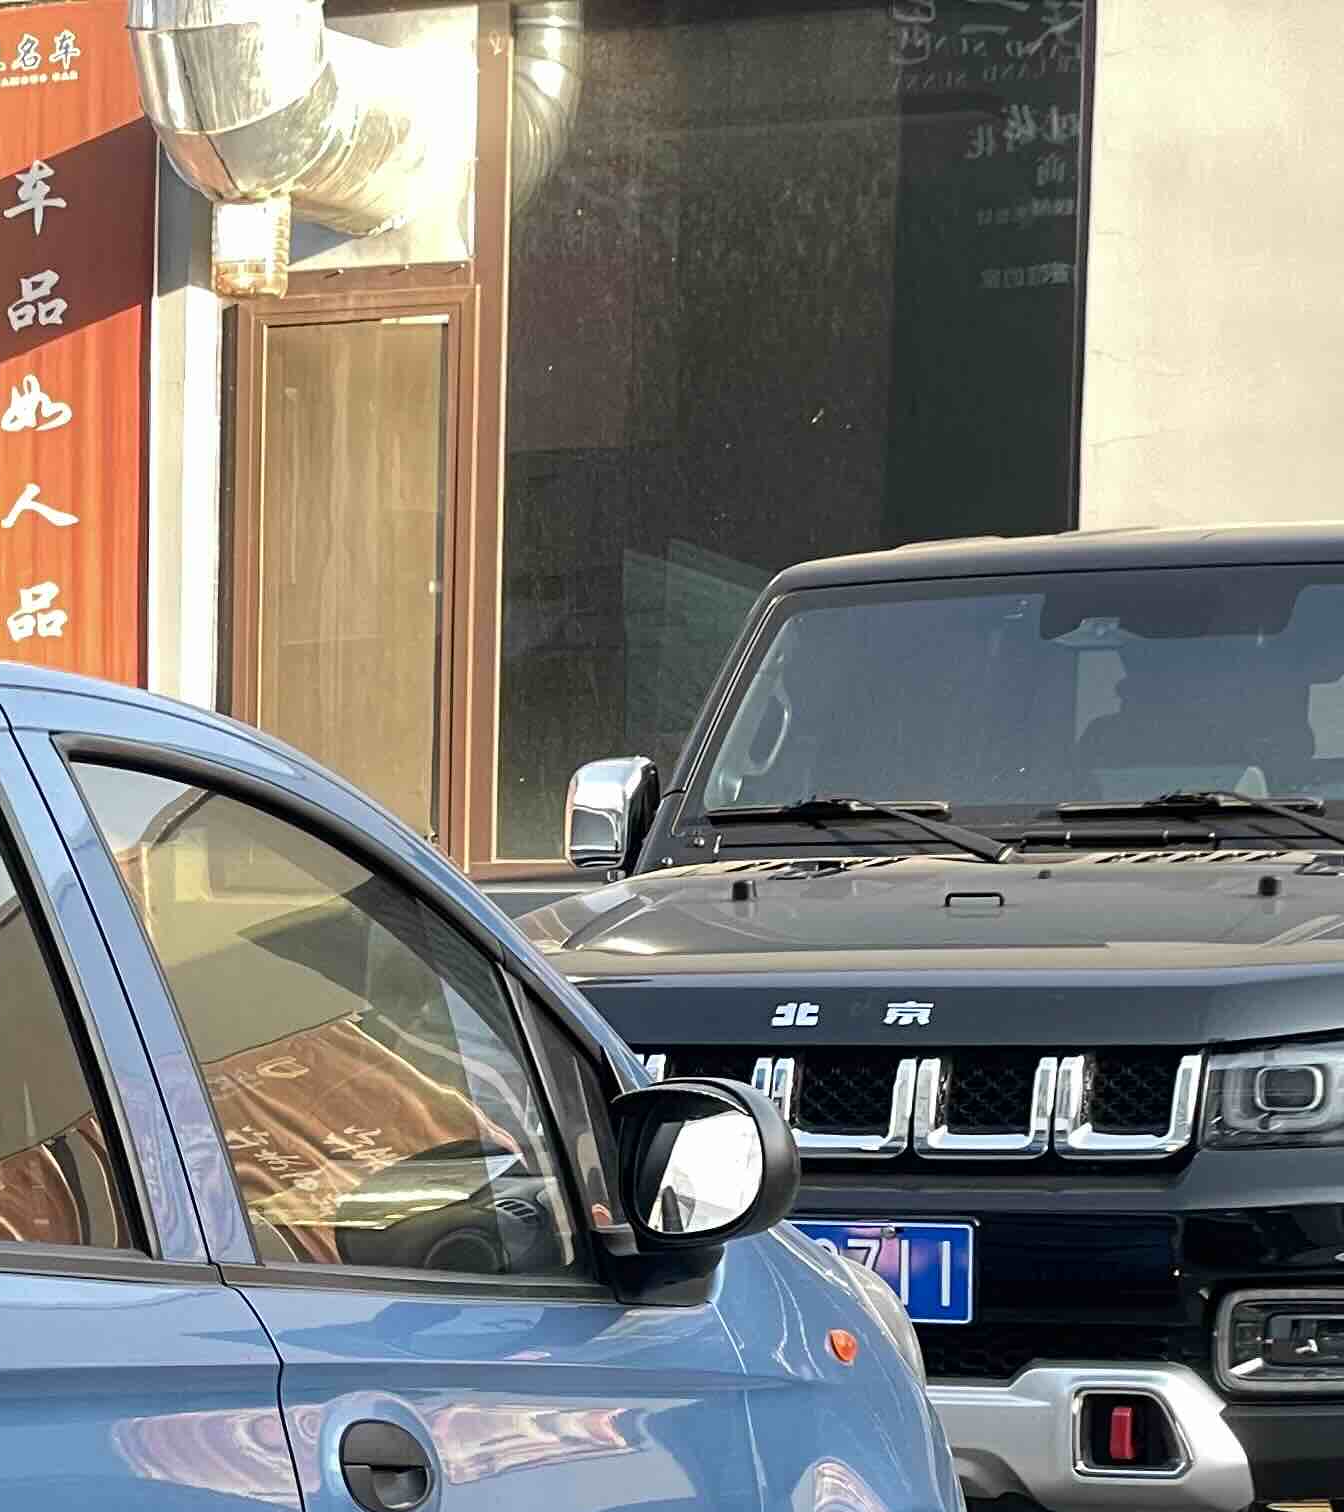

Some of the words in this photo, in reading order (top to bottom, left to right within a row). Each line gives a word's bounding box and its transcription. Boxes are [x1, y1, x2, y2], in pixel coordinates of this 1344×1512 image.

[2, 160, 80, 643] 车品如人品
[771, 1000, 934, 1027] 北京
